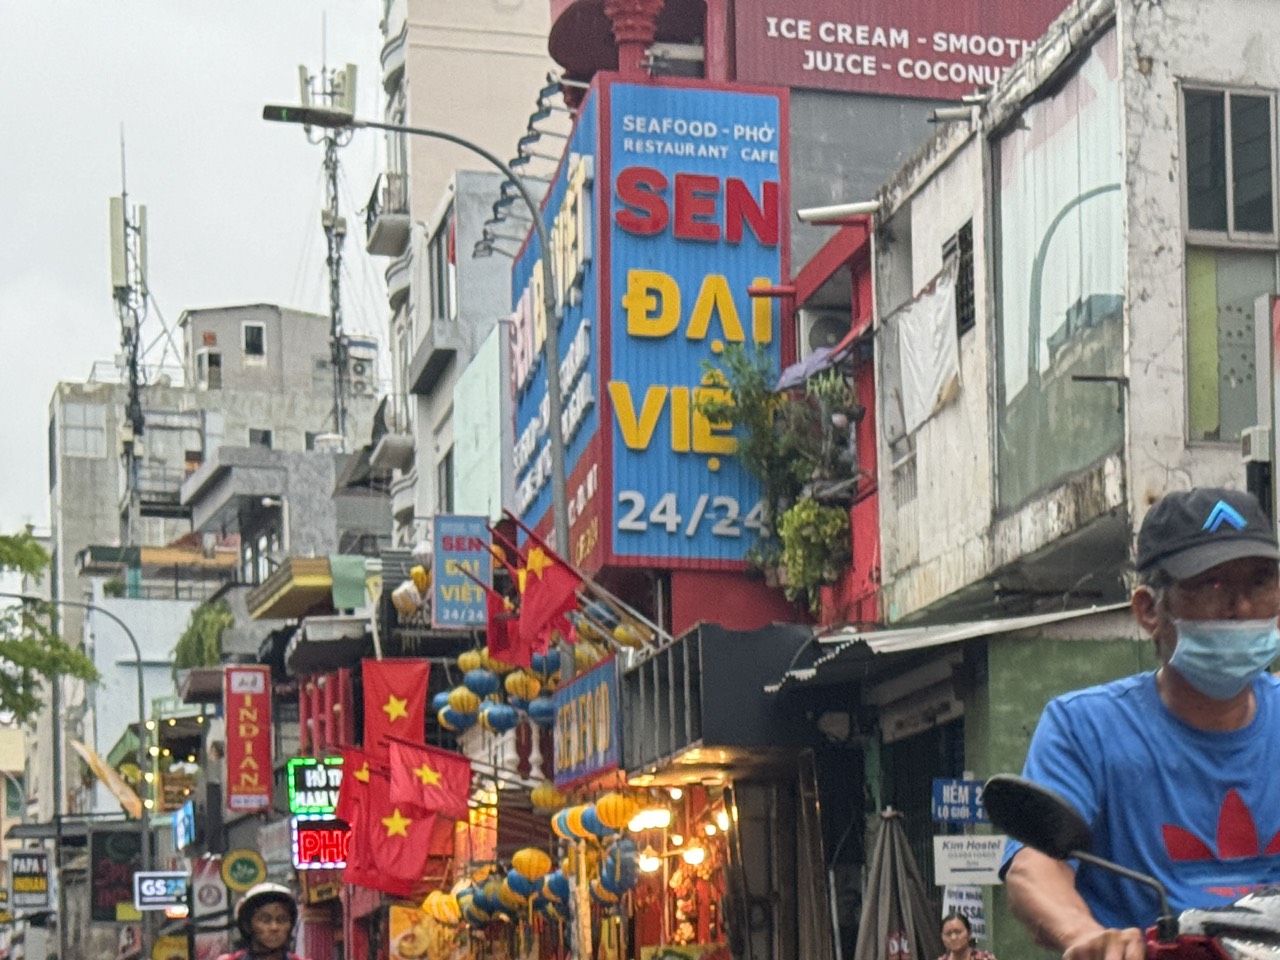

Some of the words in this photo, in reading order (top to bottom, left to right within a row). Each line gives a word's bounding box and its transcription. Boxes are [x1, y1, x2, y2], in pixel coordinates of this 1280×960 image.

[766, 17, 811, 40] ICE
[819, 22, 909, 48] CREAM
[803, 50, 877, 75] JUICE
[623, 115, 717, 138] SEAFOOD
[623, 138, 729, 159] RESTAURANT
[615, 166, 780, 246] SEN
[622, 268, 773, 353] ĐẠI
[442, 535, 481, 552] SEN
[239, 694, 260, 787] INDIAN
[942, 840, 963, 850] Kim
[966, 839, 1001, 851] Hostel
